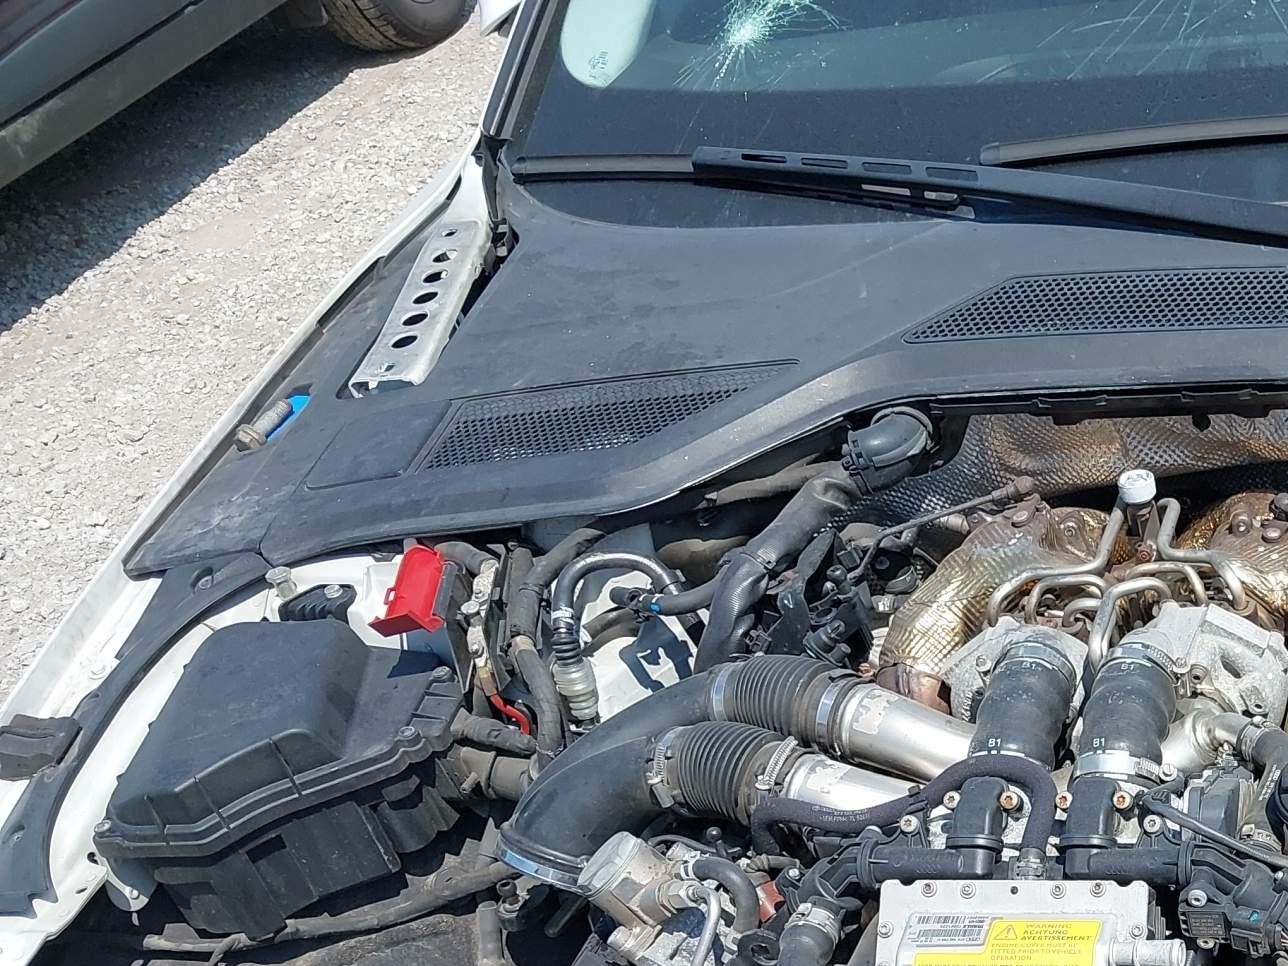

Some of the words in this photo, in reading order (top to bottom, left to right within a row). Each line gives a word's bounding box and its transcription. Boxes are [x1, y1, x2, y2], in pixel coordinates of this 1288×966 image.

[1021, 661, 1036, 670] B1
[988, 738, 1001, 747] B1
[1092, 738, 1105, 748] B1
